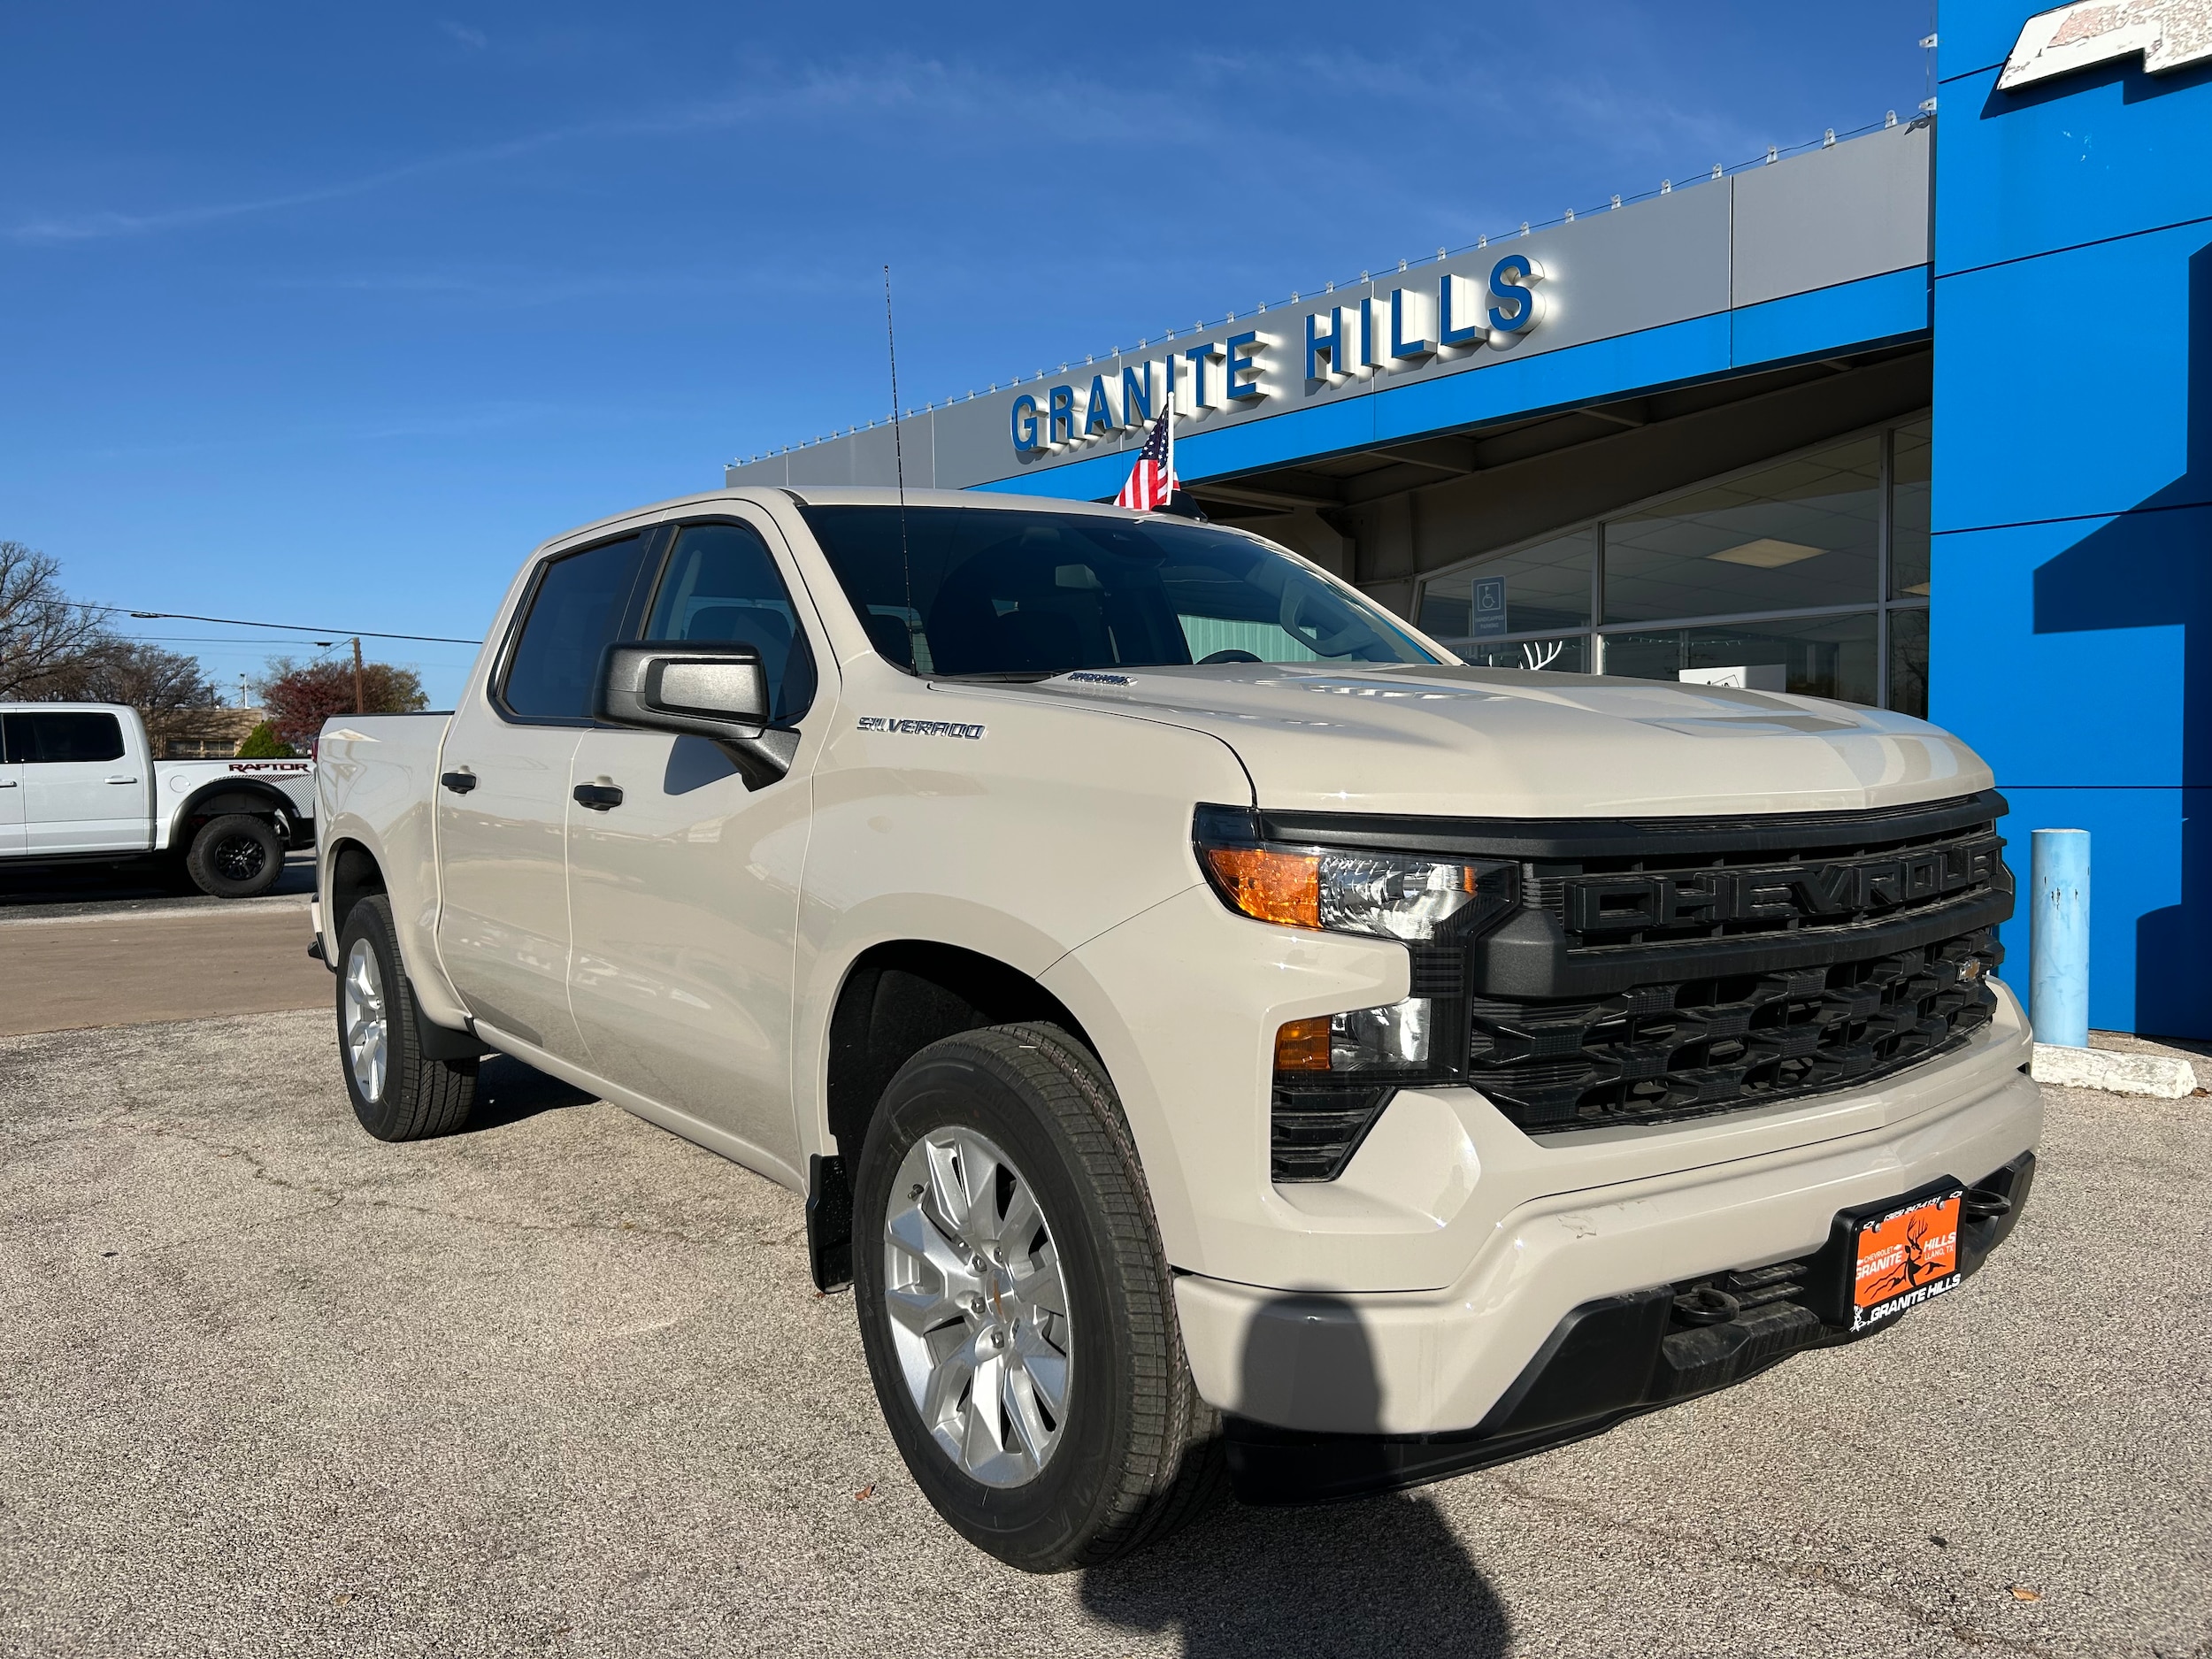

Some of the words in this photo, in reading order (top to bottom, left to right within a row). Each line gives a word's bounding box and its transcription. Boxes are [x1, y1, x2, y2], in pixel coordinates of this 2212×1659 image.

[1011, 330, 1270, 452] GRANITE
[1304, 254, 1546, 382] HILLS
[856, 717, 987, 741] SILVERADO
[229, 764, 311, 773] RAPTOR
[1564, 837, 2006, 933] CHEVROLET
[1855, 1250, 1902, 1280] GRANITE
[1924, 1231, 1956, 1252] HILLS
[1863, 1247, 1893, 1263] CHEVROLET
[1924, 1248, 1945, 1261] LLANO,
[1947, 1244, 1954, 1253] TX
[1870, 1286, 1926, 1322] GRANITE
[1927, 1274, 1962, 1299] HILLS
